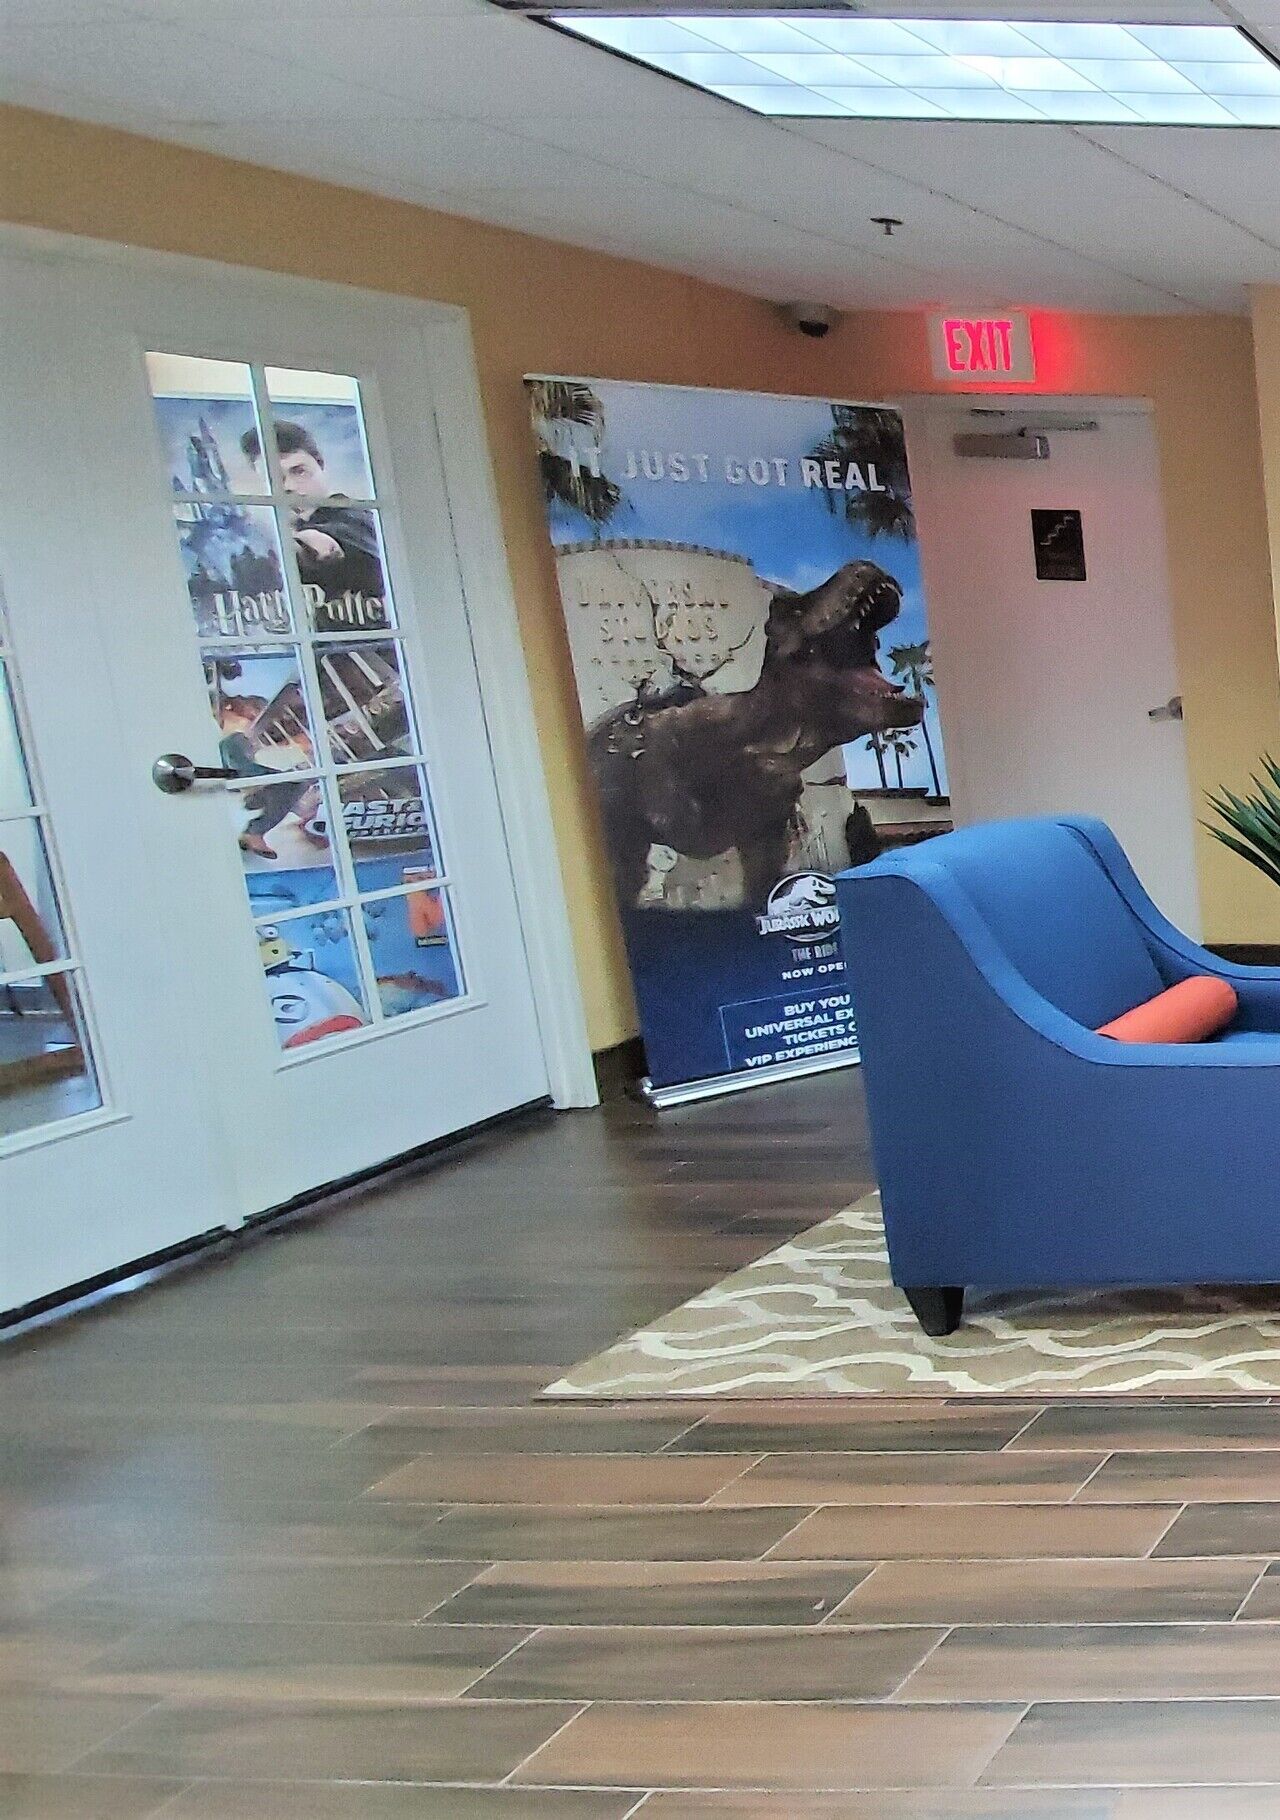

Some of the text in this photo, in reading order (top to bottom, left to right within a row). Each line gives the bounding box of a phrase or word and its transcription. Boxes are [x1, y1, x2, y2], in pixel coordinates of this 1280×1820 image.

[944, 320, 1013, 371] EXIT
[570, 447, 886, 492] IT JUST GOT REAL
[301, 583, 384, 627] Potte
[791, 946, 812, 961] THE
[781, 961, 848, 980] NOW OPE
[783, 994, 851, 1016] BUY YOU
[745, 1008, 854, 1038] UNIVERSAL EX
[781, 1024, 845, 1045] TICKETS
[745, 1035, 858, 1067] VIP EXPERIENC
